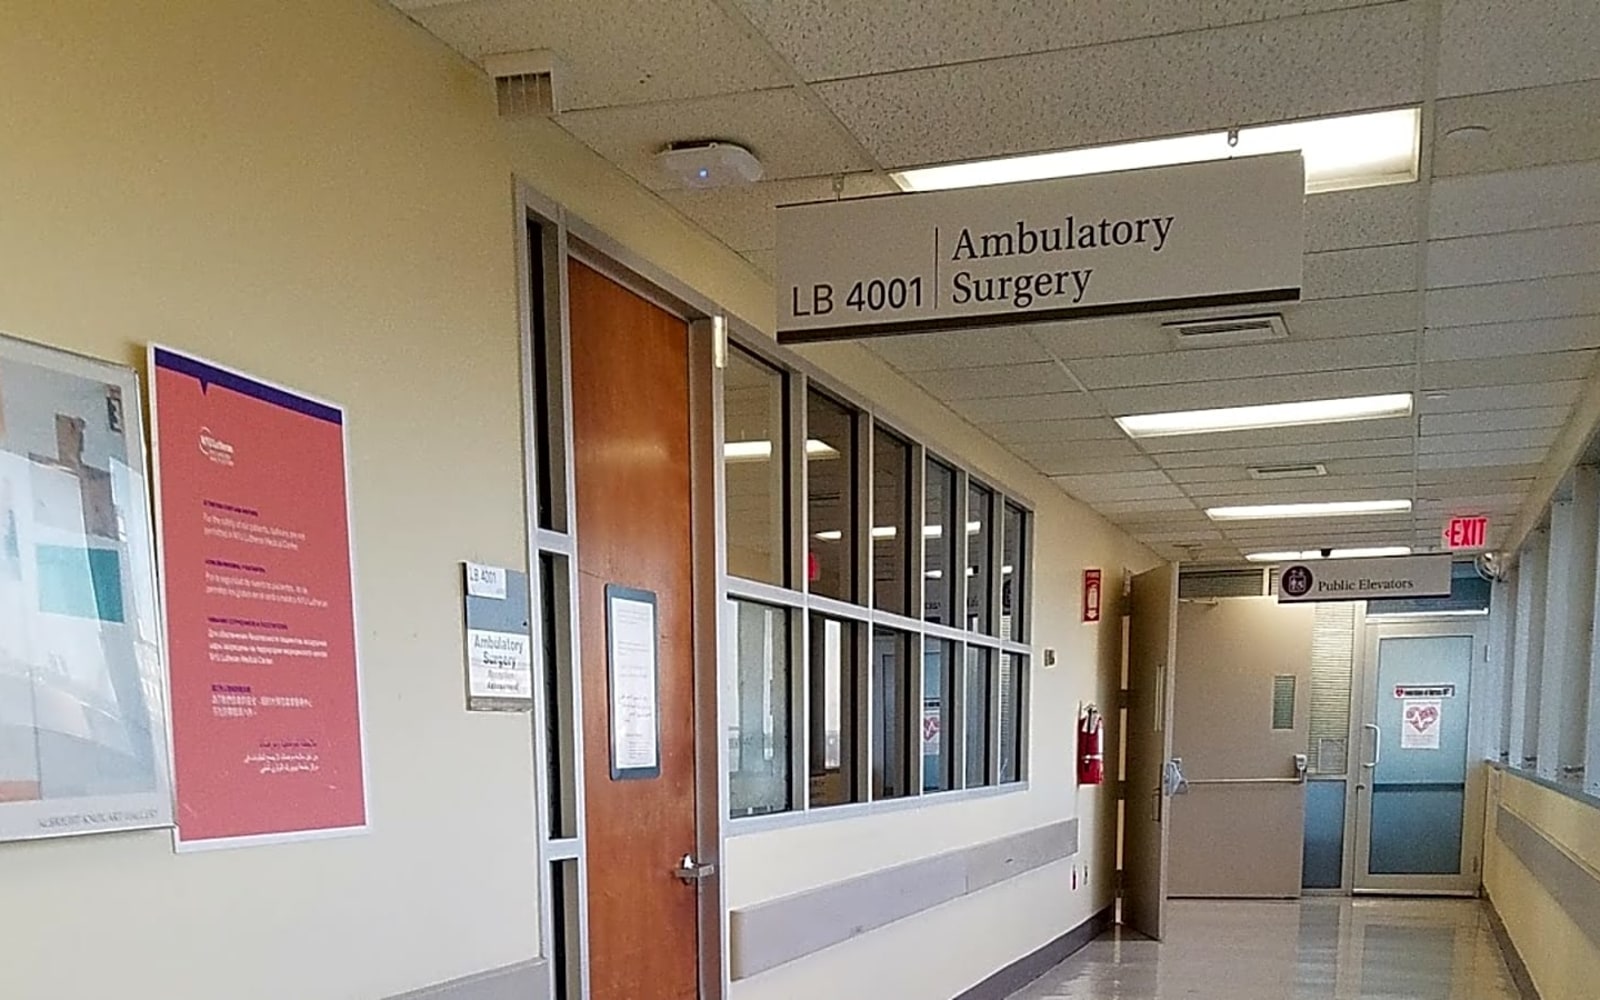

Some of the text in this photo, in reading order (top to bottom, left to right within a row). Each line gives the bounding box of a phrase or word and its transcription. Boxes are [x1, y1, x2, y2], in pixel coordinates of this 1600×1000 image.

[952, 216, 1175, 260] Ambulatory
[792, 276, 922, 317] LB 4001
[951, 268, 1093, 308] Surgery
[1450, 518, 1487, 546] EXIT
[469, 567, 479, 582] LB
[1317, 577, 1414, 592] Public Elevators
[474, 634, 524, 655] Ambulatory
[482, 651, 517, 670] Surgery
